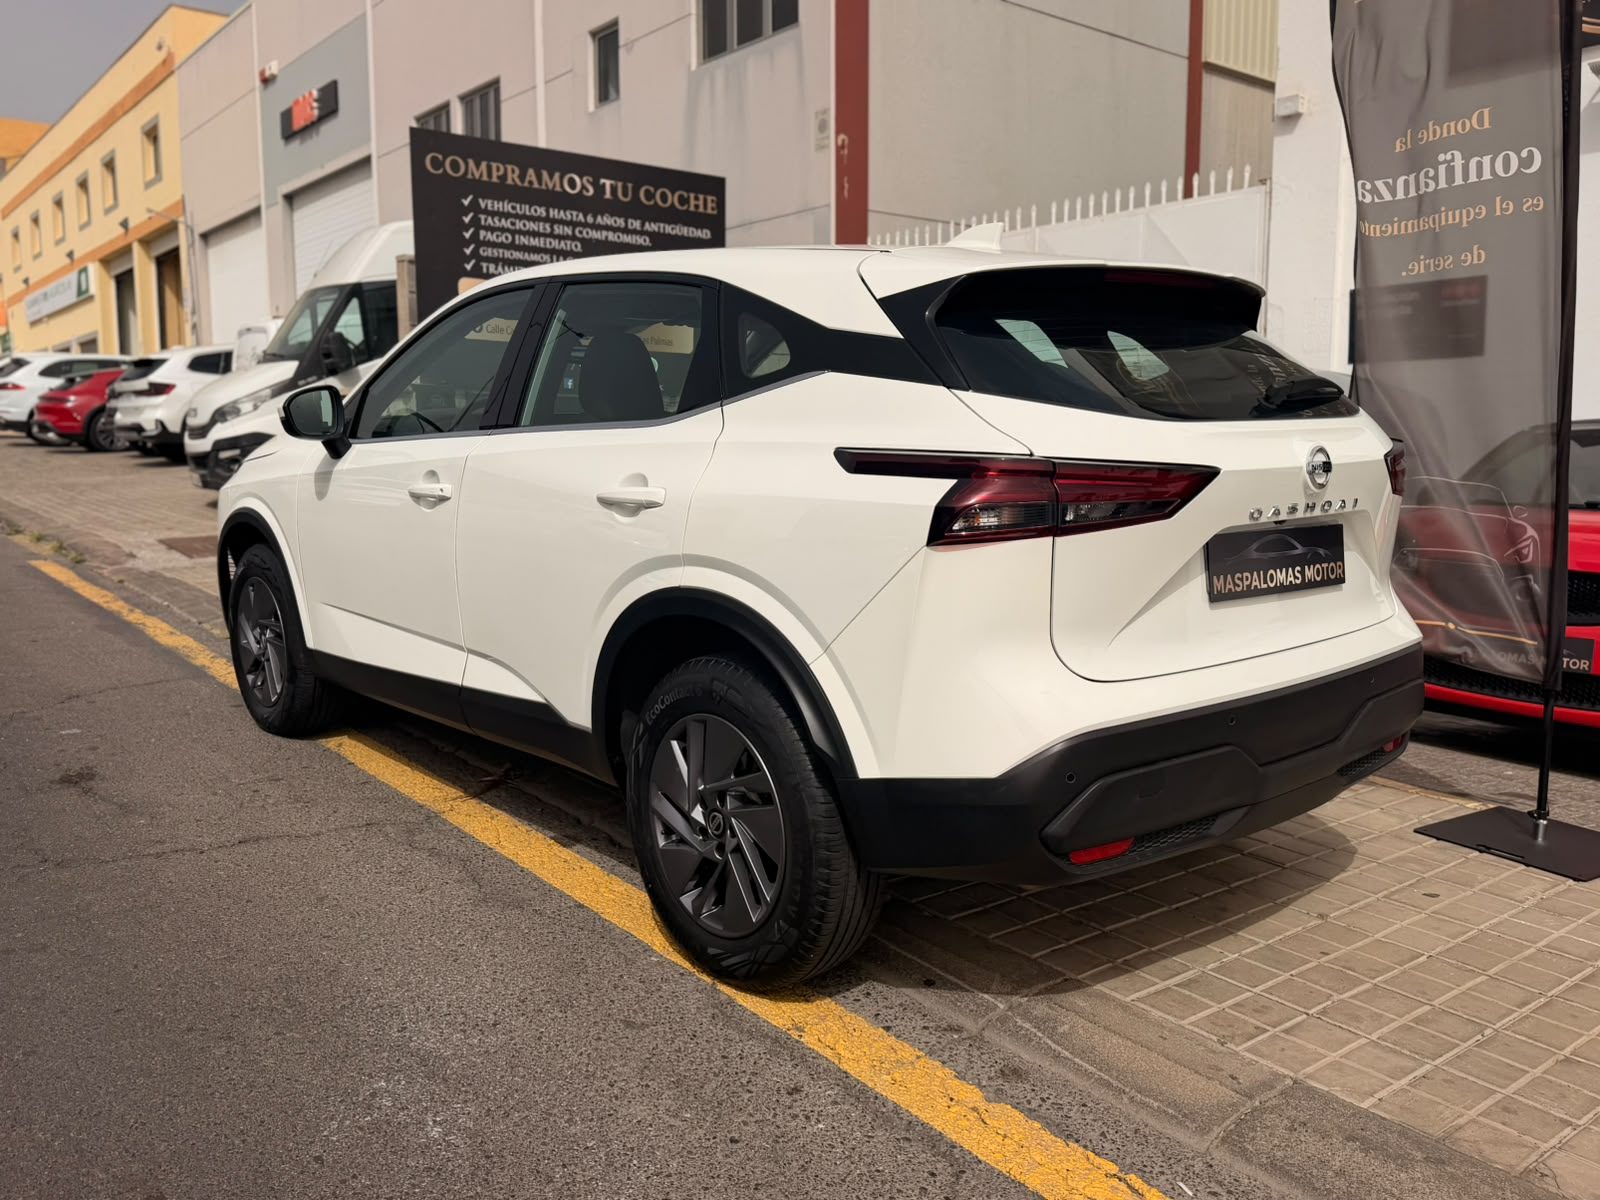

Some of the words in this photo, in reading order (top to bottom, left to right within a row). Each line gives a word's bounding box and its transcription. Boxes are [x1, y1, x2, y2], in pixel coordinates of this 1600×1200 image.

[424, 152, 595, 197] COMPRAMOS
[600, 178, 634, 203] TU
[639, 185, 718, 215] COCHE
[478, 198, 546, 218] VEHÍCULOS
[549, 207, 585, 224] HASTA
[586, 212, 594, 225] 6
[595, 213, 626, 229] AÑOS
[627, 218, 642, 231] DE
[643, 221, 712, 240] ANTIGÜEDAD.
[478, 214, 551, 235] TASACIONES
[553, 223, 573, 236] SIN
[575, 226, 652, 247] COMPROMISO.
[479, 229, 512, 244] PAGO
[514, 234, 583, 253] INMEDIATO.
[479, 246, 551, 264] GESTIONAMOS
[1213, 566, 1302, 594] MASPALOMAS
[1304, 561, 1344, 583] MOTOR
[1562, 657, 1590, 672] TOR
